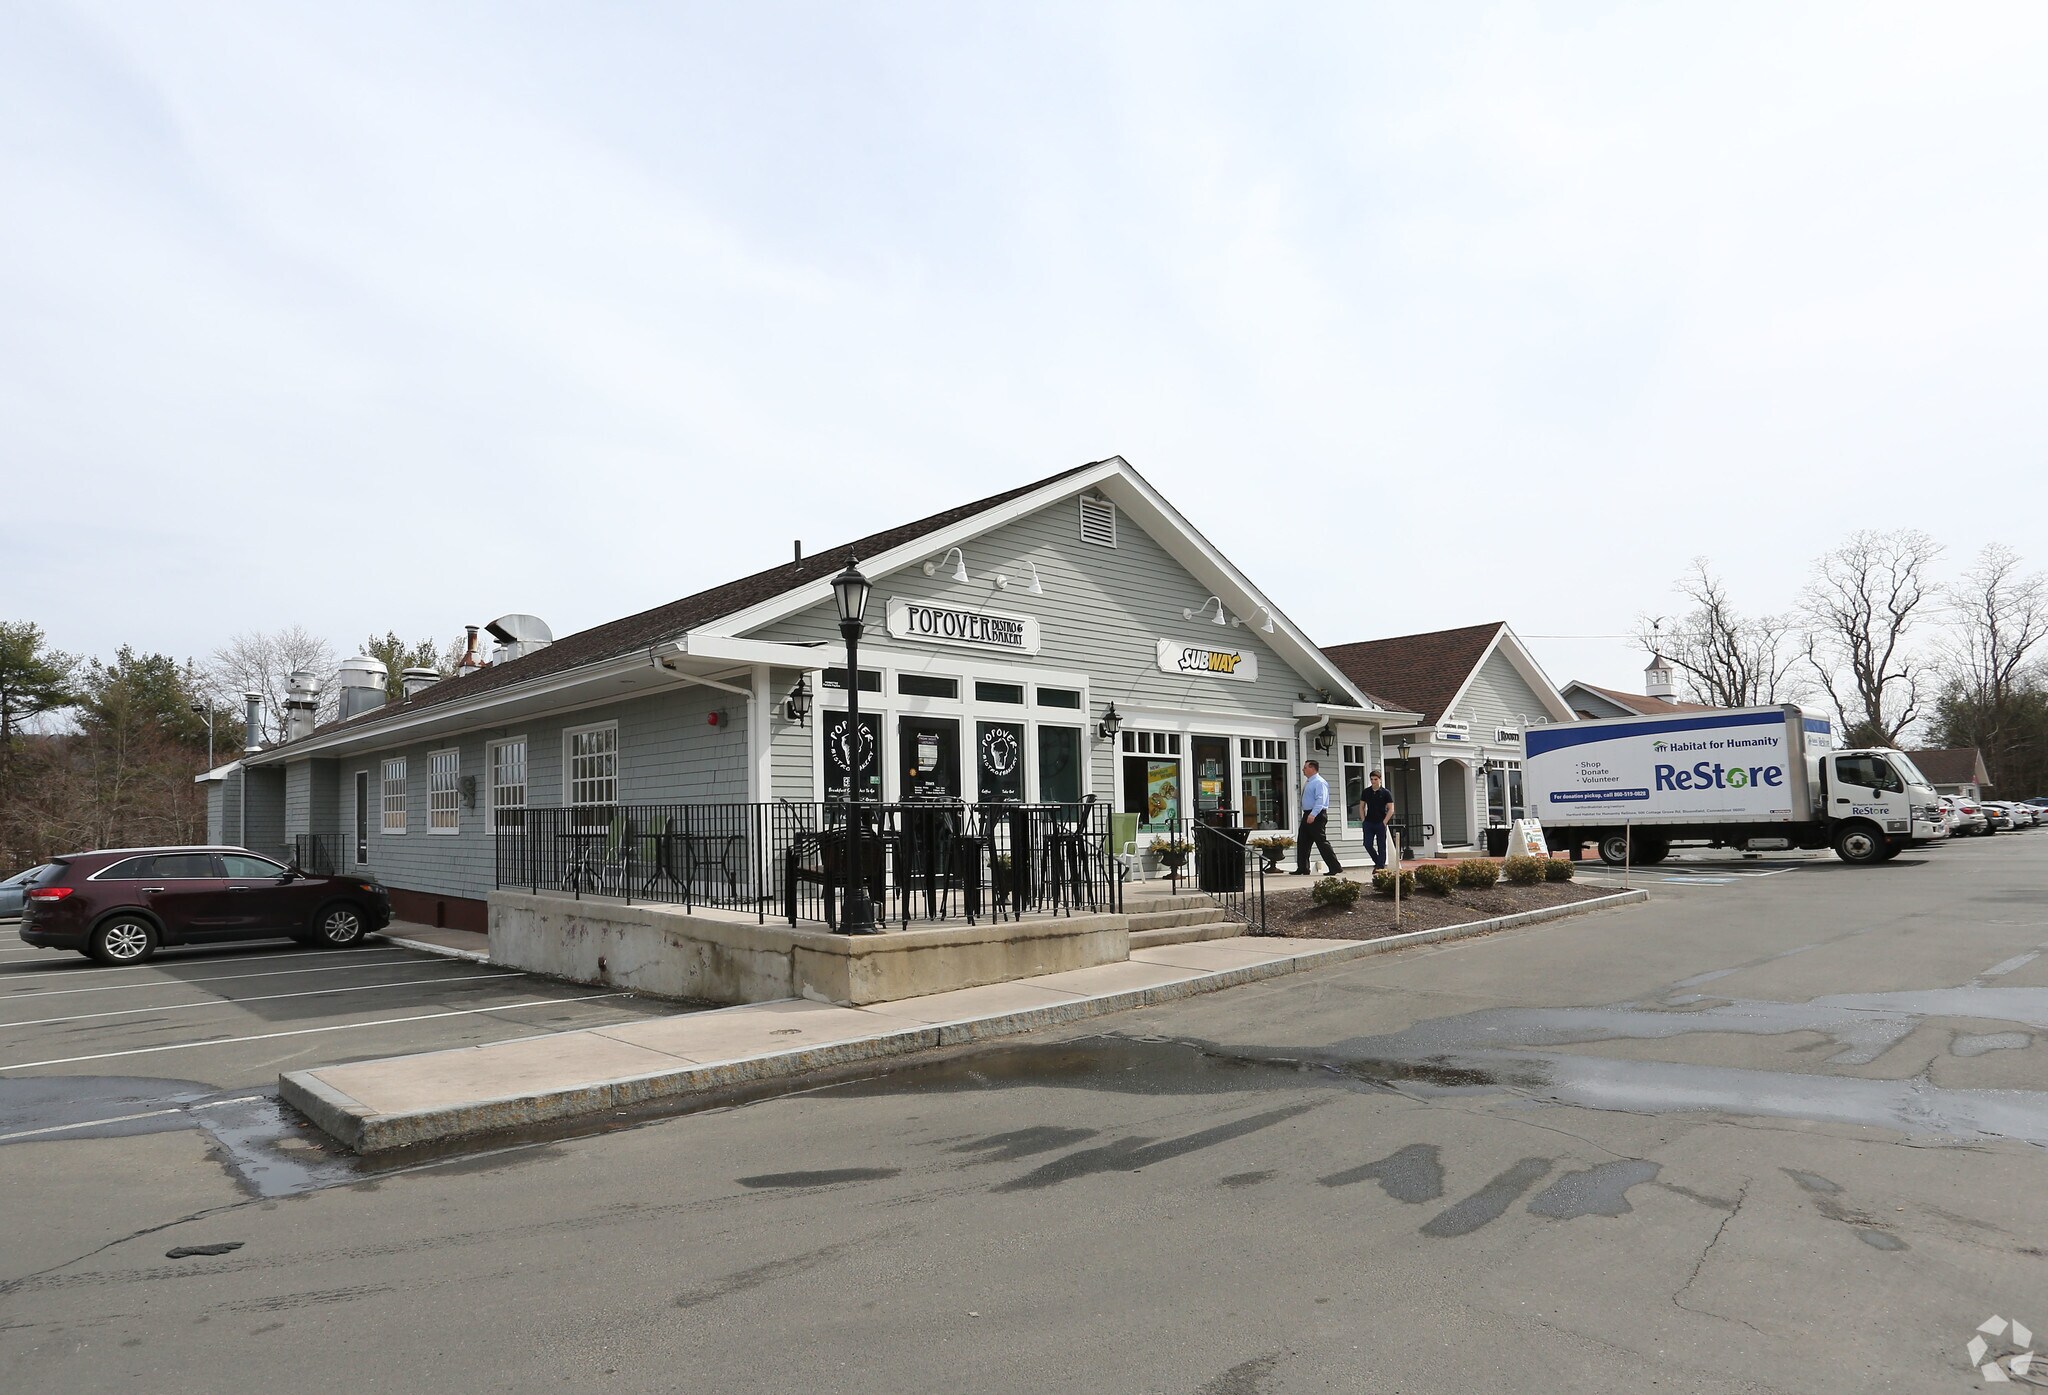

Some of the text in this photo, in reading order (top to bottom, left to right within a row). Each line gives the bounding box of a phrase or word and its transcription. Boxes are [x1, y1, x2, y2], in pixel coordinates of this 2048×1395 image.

[908, 607, 992, 641] POPOVER
[992, 619, 1017, 632] BISTRO
[992, 630, 1023, 645] BAKERY
[1179, 648, 1241, 673] SUBWAY
[830, 720, 874, 743] POPER
[982, 728, 1018, 749] POPOVER
[1670, 736, 1779, 752] Habitat for Humanity
[1580, 761, 1601, 769] Shop
[1582, 776, 1620, 784] Volunteer
[1655, 761, 1783, 791] ReStore
[1852, 806, 1889, 815] ReStore
